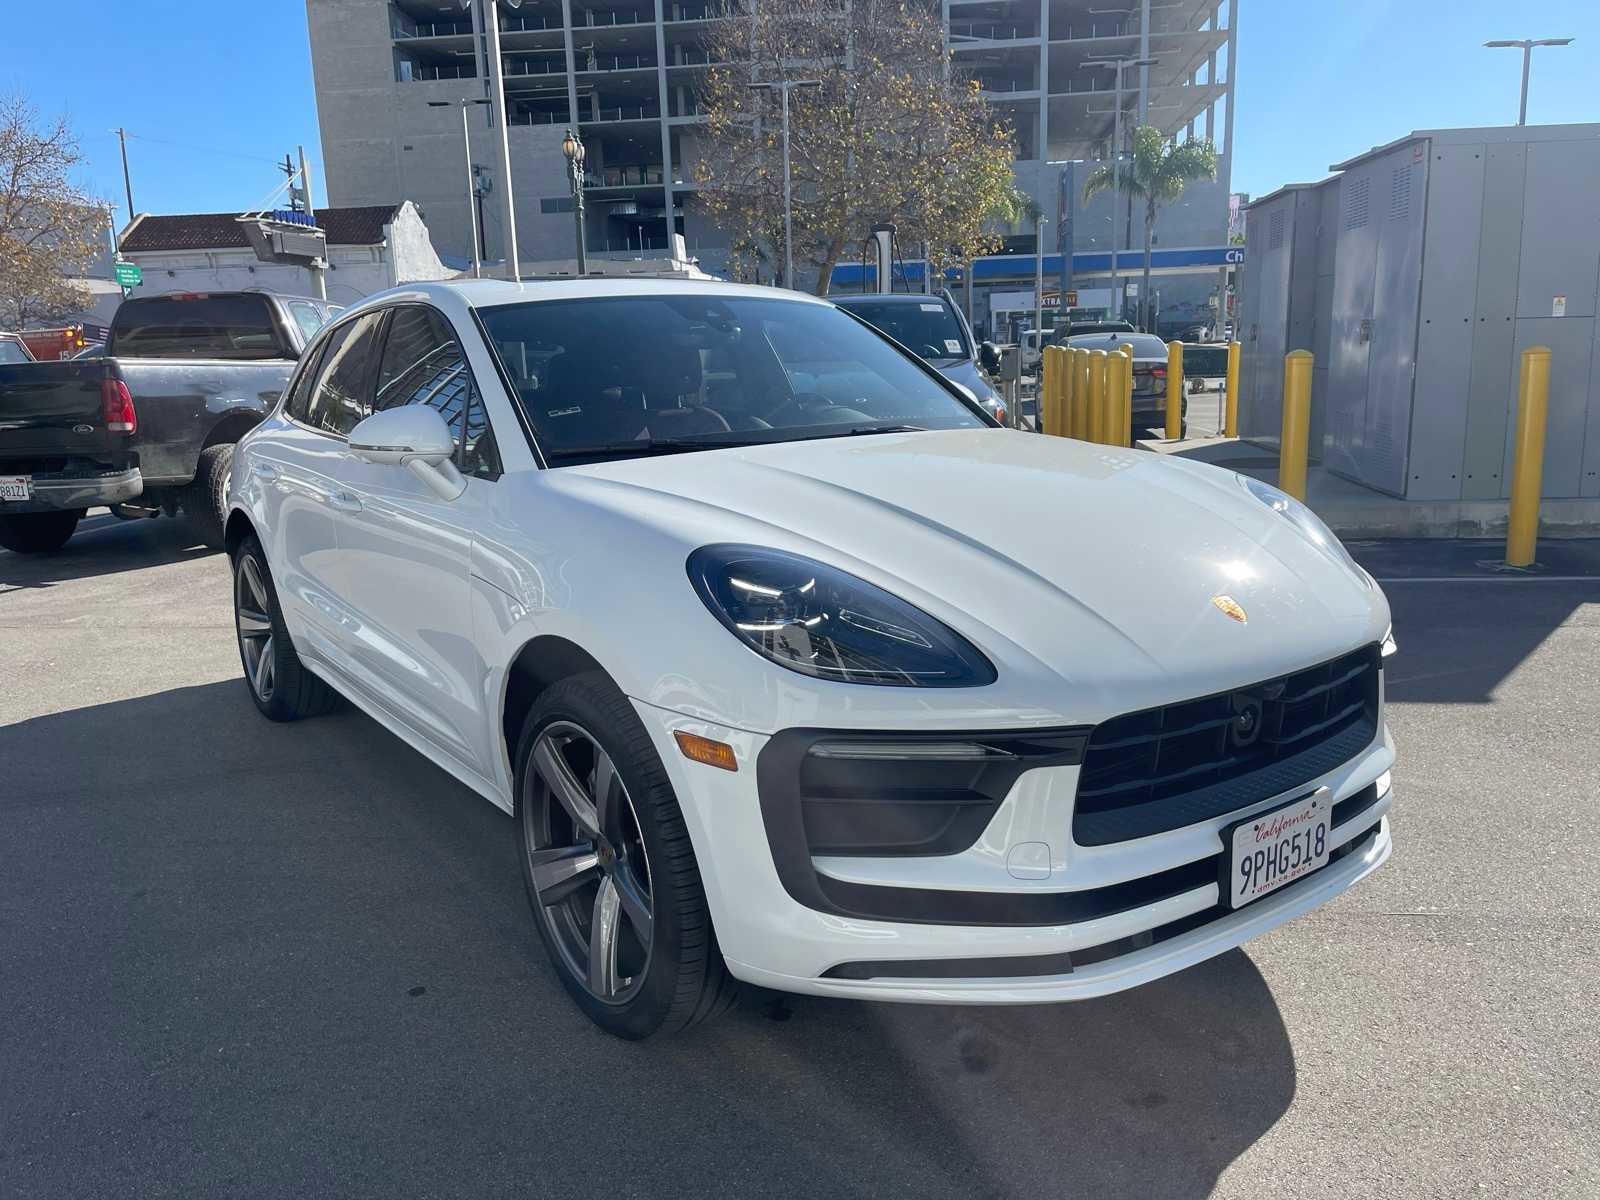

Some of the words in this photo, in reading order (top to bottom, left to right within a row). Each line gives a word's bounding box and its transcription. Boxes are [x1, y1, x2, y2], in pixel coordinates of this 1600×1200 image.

[1226, 250, 1243, 262] Ch
[1255, 808, 1316, 842] California
[1240, 822, 1326, 895] 9PHG518
